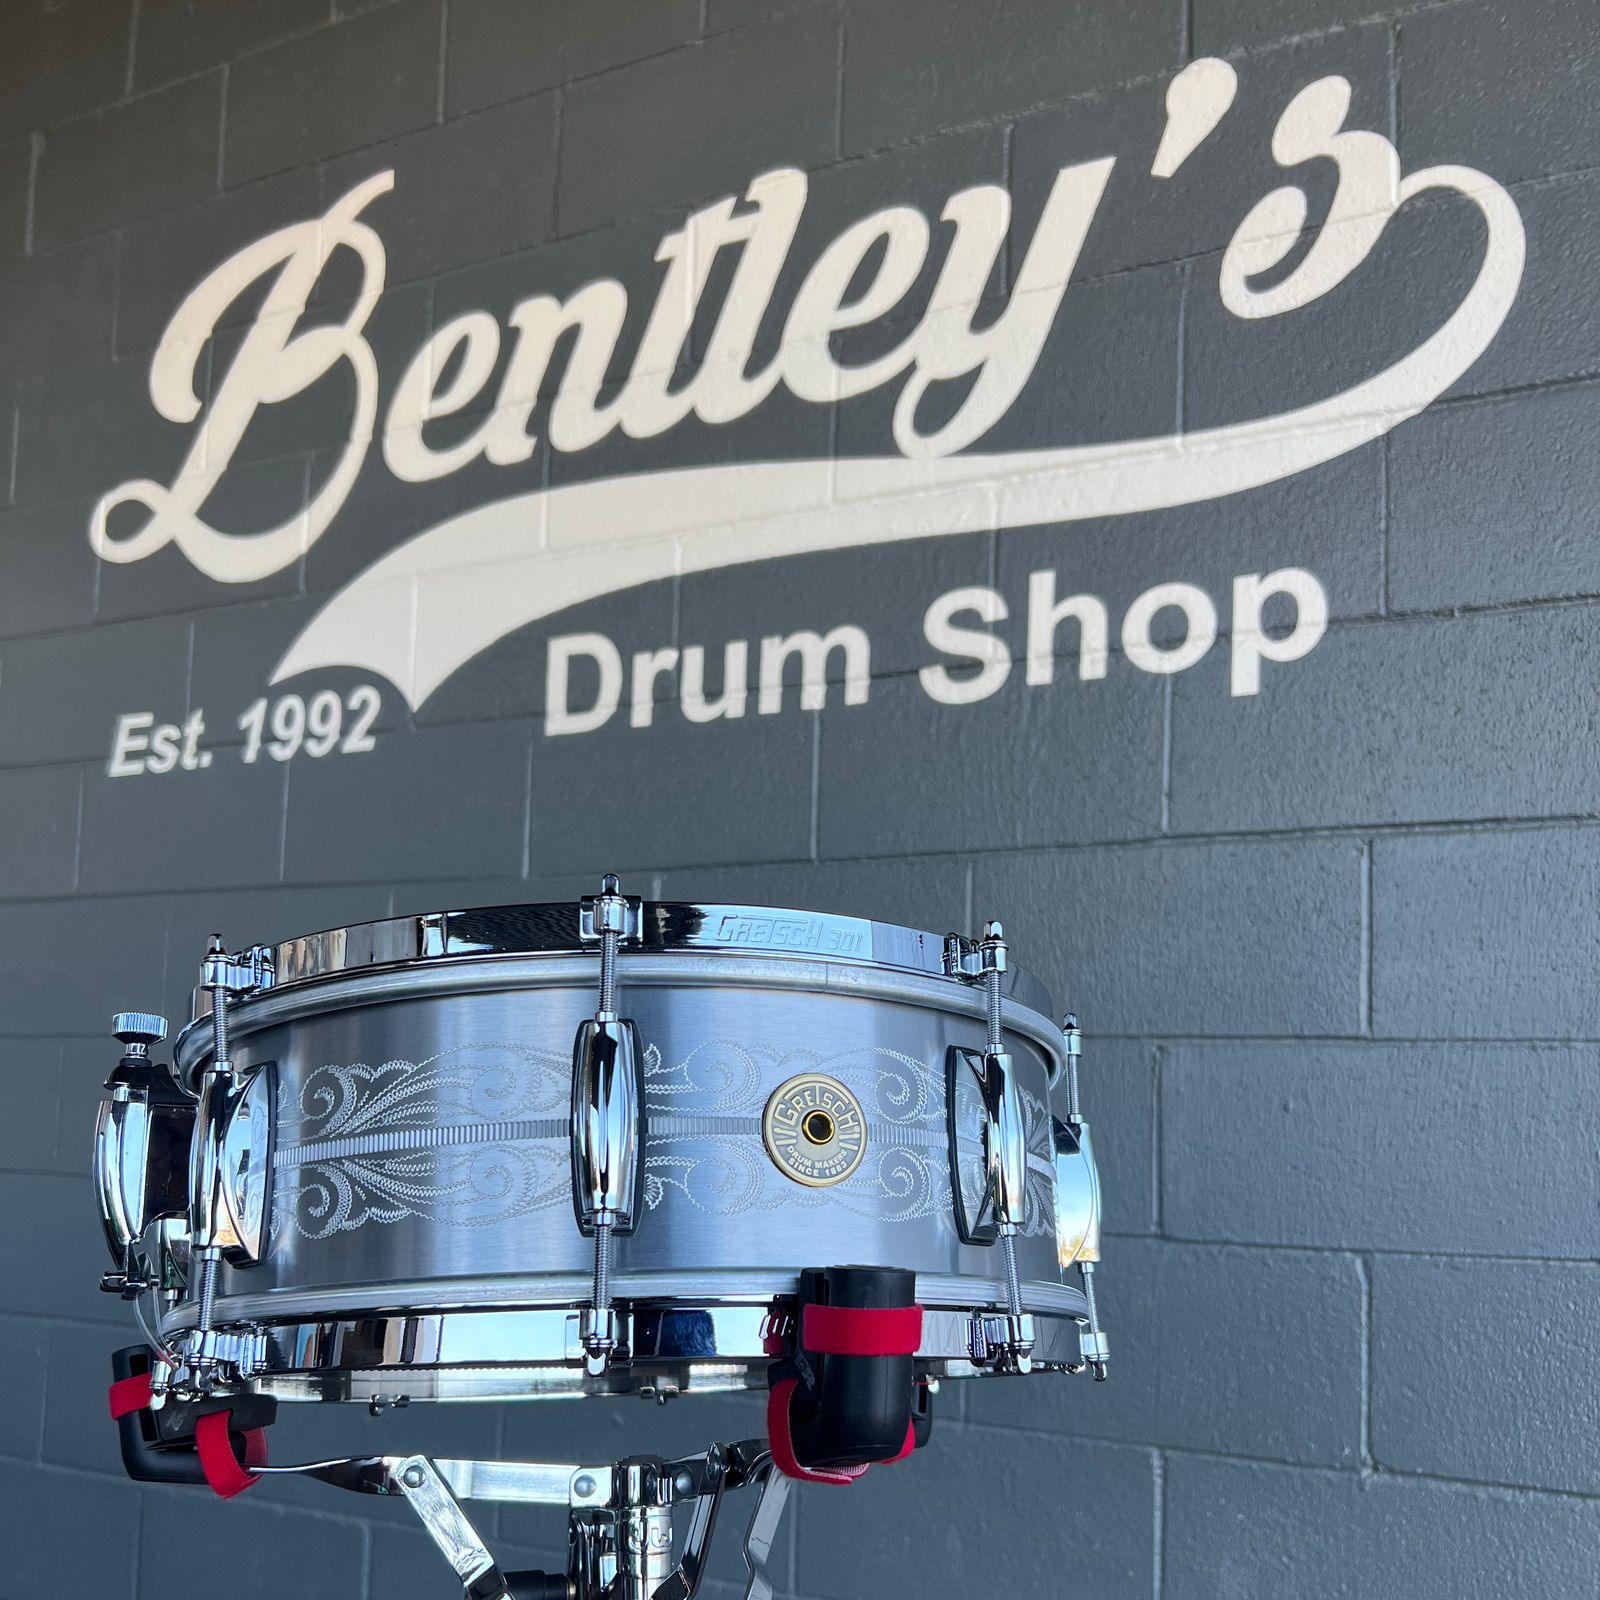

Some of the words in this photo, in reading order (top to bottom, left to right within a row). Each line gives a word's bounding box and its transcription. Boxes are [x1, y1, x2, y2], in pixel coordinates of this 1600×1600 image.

[90, 57, 1526, 583] Bentley's
[545, 626, 871, 737] Drum
[919, 567, 1330, 705] Shop
[108, 709, 213, 778] Est.
[238, 685, 382, 764] 1992
[715, 913, 824, 948] GRETSCH
[827, 931, 863, 952] 301
[773, 1082, 860, 1129] GRETSCH
[787, 1145, 812, 1167] DRUM
[814, 1149, 848, 1168] MAKERS
[788, 1157, 819, 1176] SINCE
